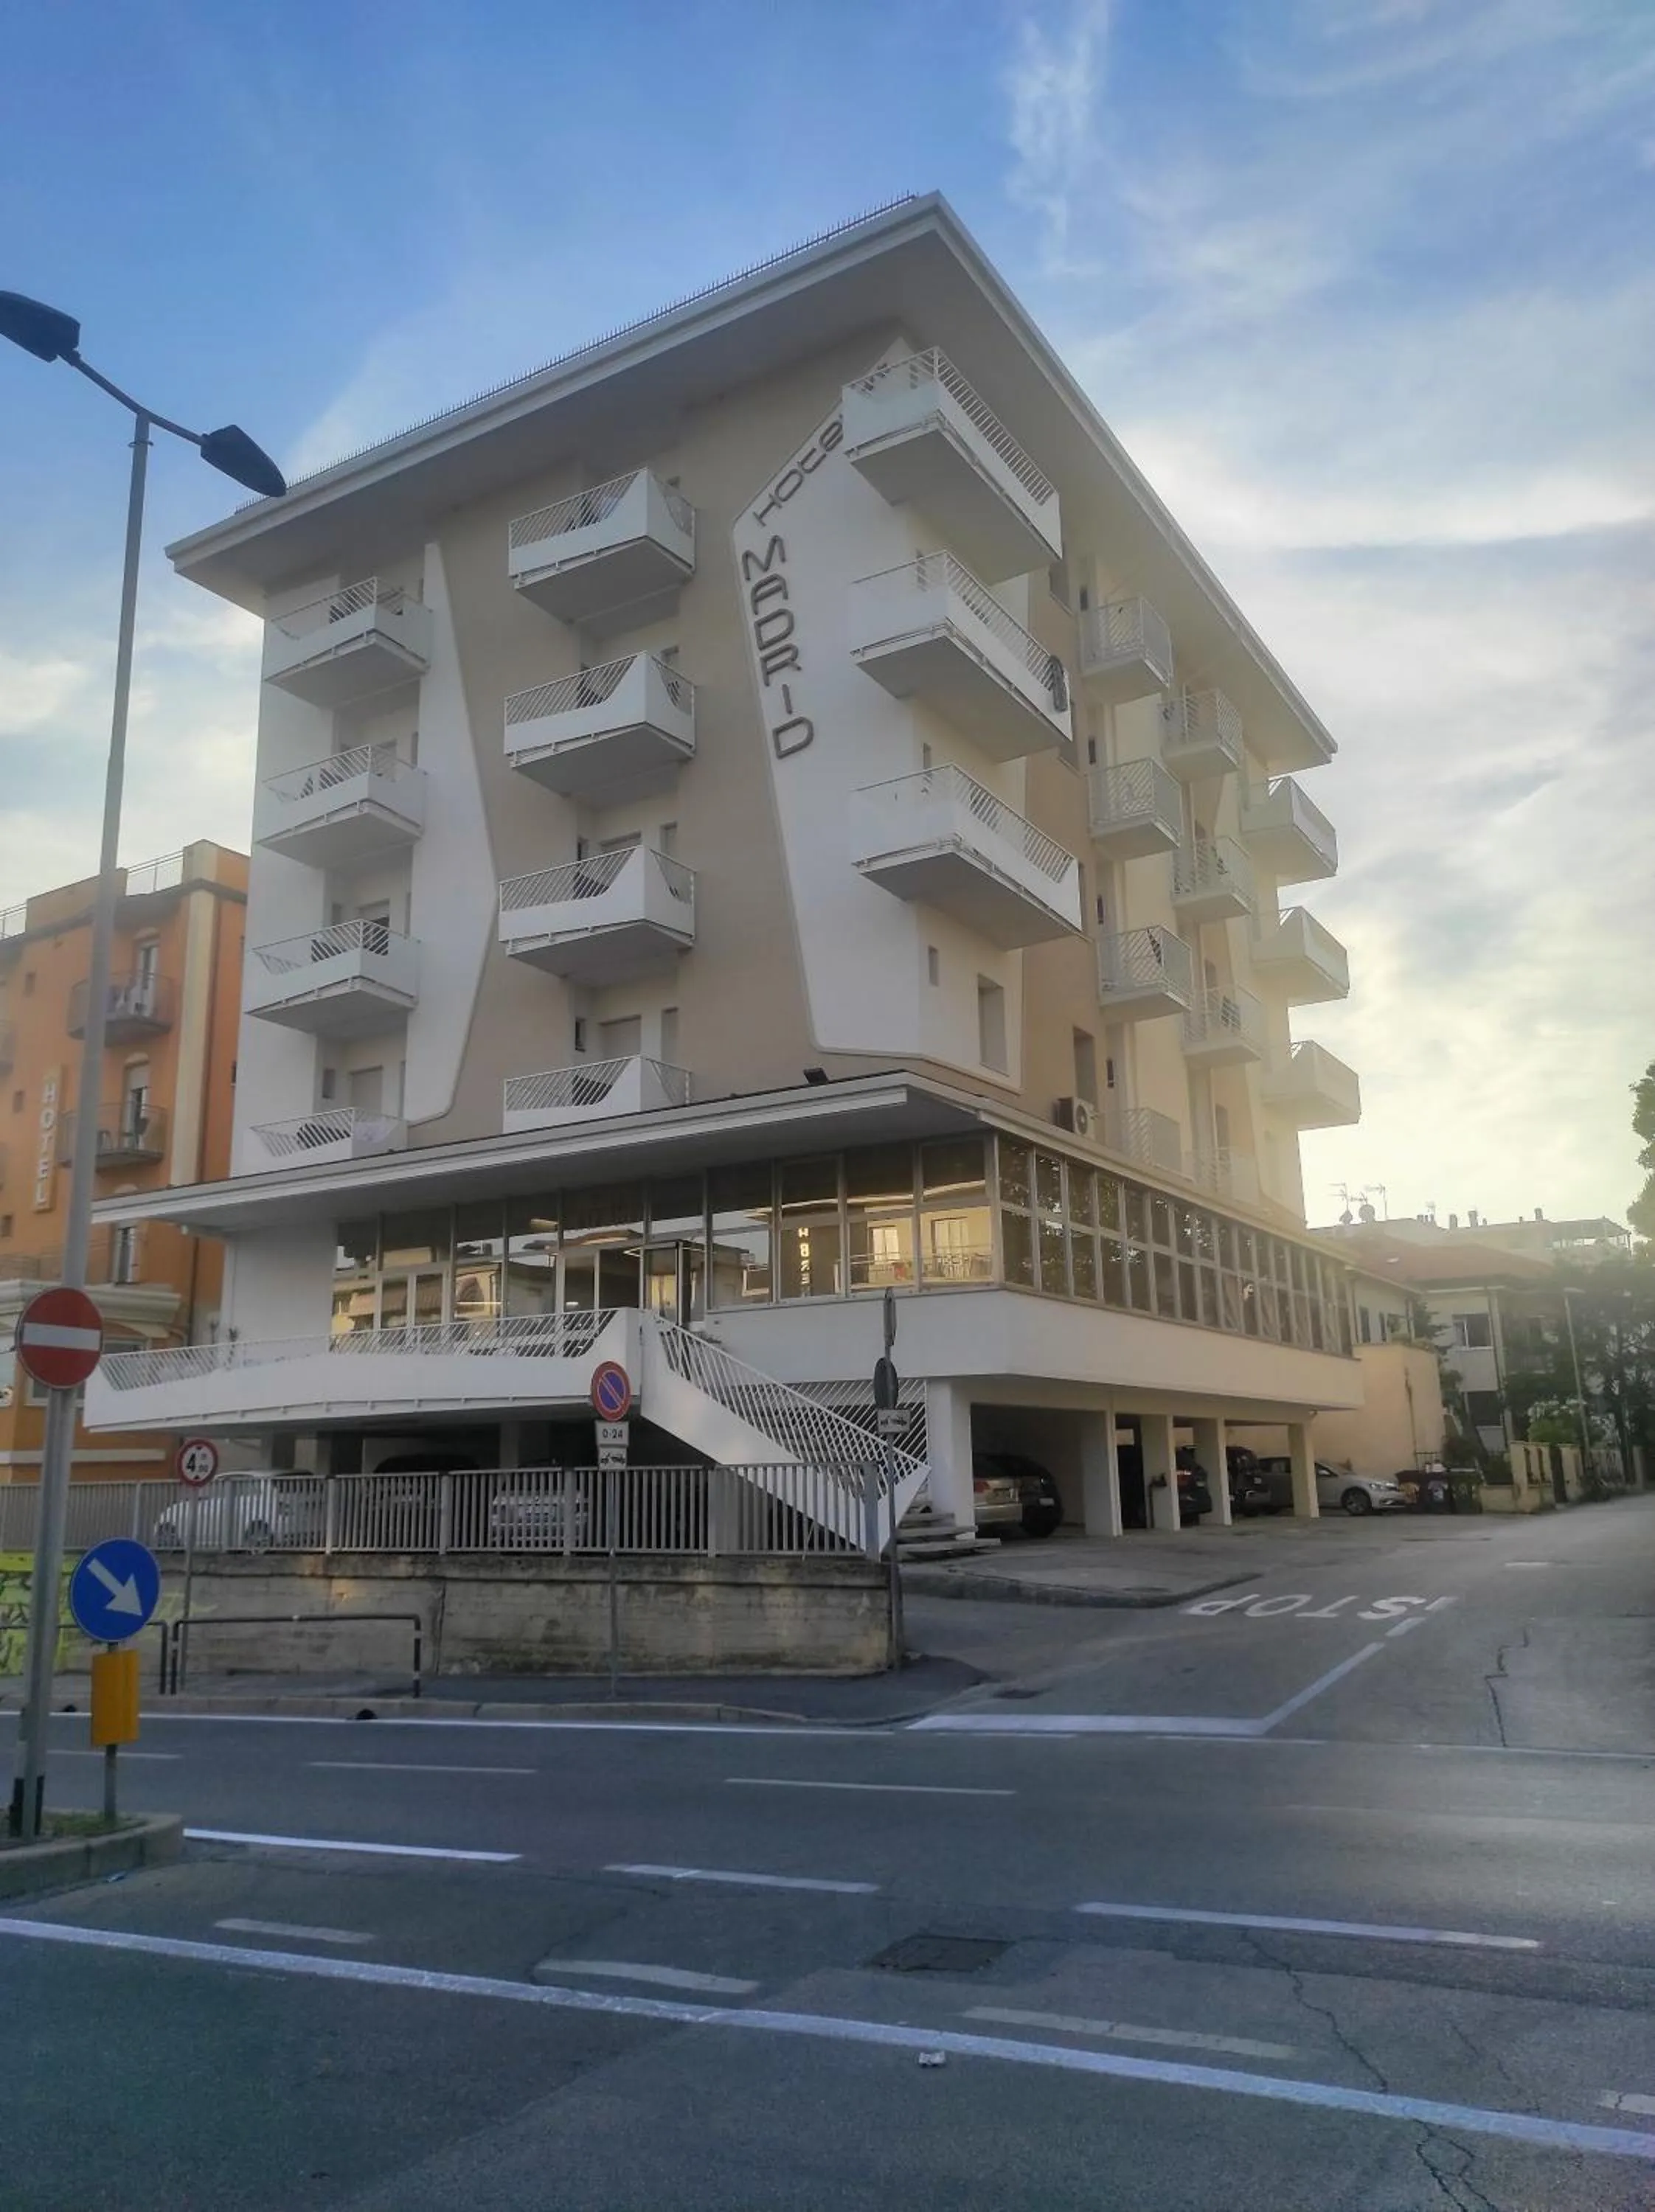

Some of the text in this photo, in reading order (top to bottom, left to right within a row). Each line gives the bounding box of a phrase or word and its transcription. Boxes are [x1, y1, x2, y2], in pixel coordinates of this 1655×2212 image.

[742, 535, 813, 759] MADRID
[36, 1081, 55, 1205] HOTEL
[1180, 1593, 1426, 1619] STOP
